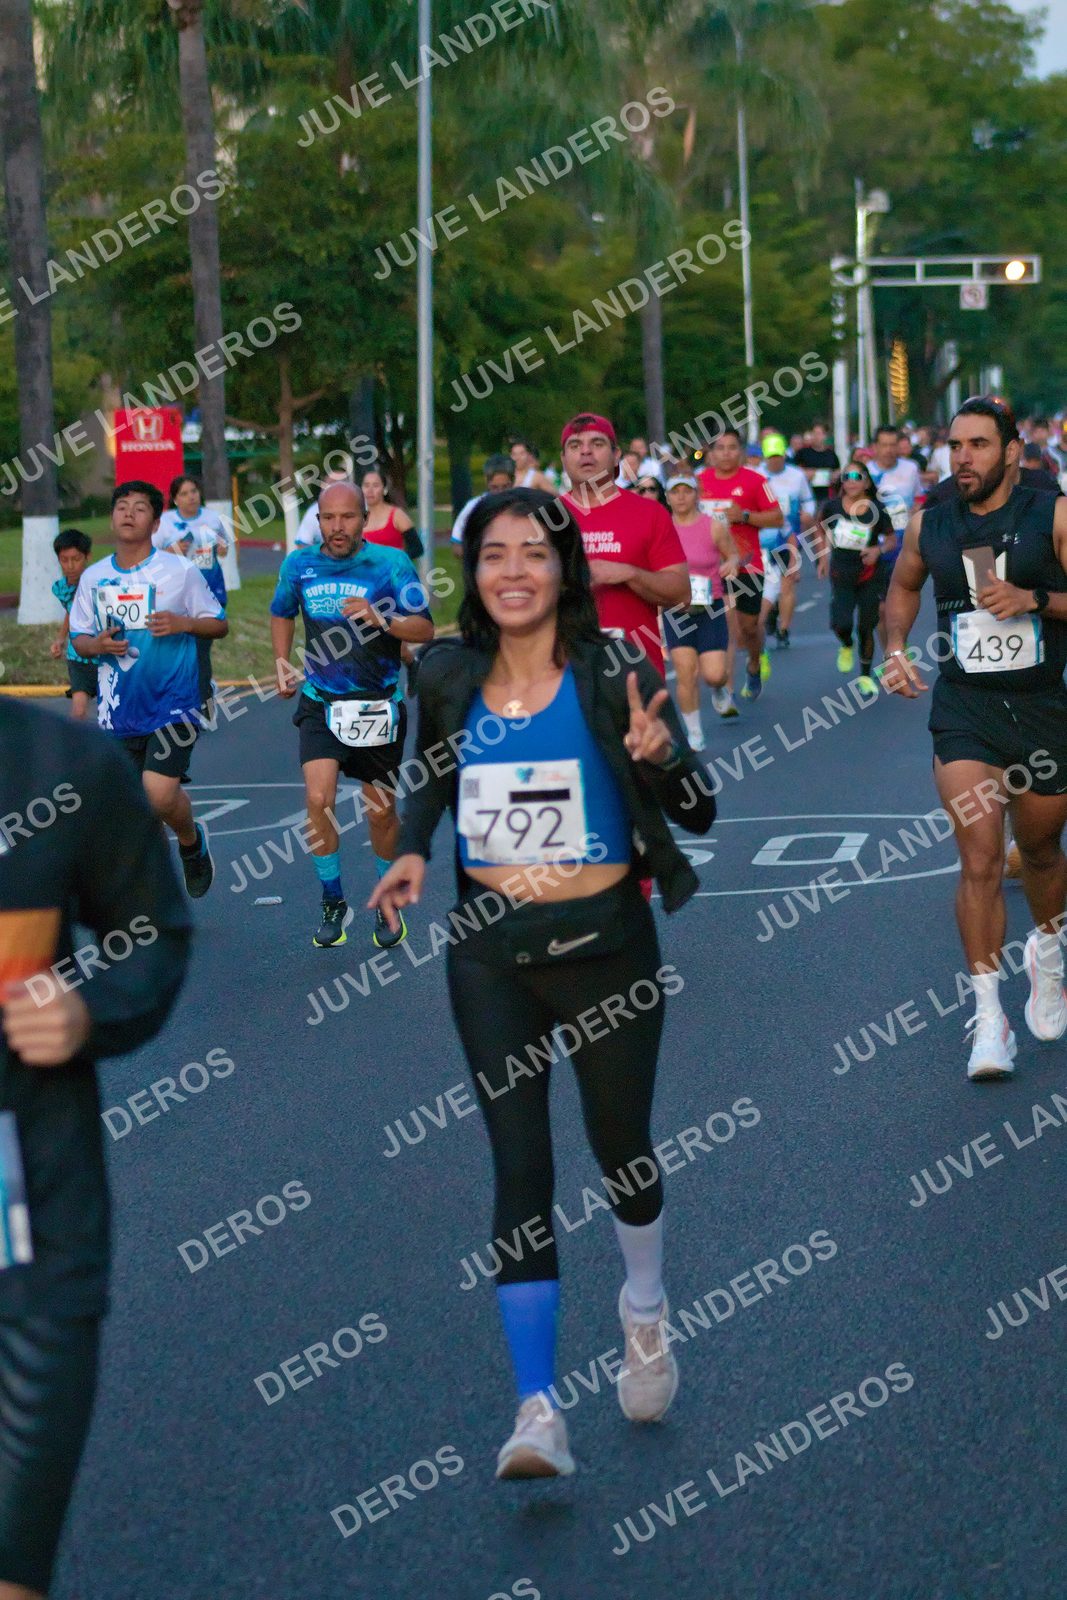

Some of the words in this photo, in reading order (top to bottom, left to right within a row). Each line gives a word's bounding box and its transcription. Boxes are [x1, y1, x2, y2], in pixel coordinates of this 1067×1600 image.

[121, 440, 176, 453] HONDA
[305, 582, 338, 598] SUPER
[339, 582, 368, 598] TEAM
[966, 634, 1024, 663] 439
[336, 719, 390, 741] 1574
[475, 806, 566, 850] 792
